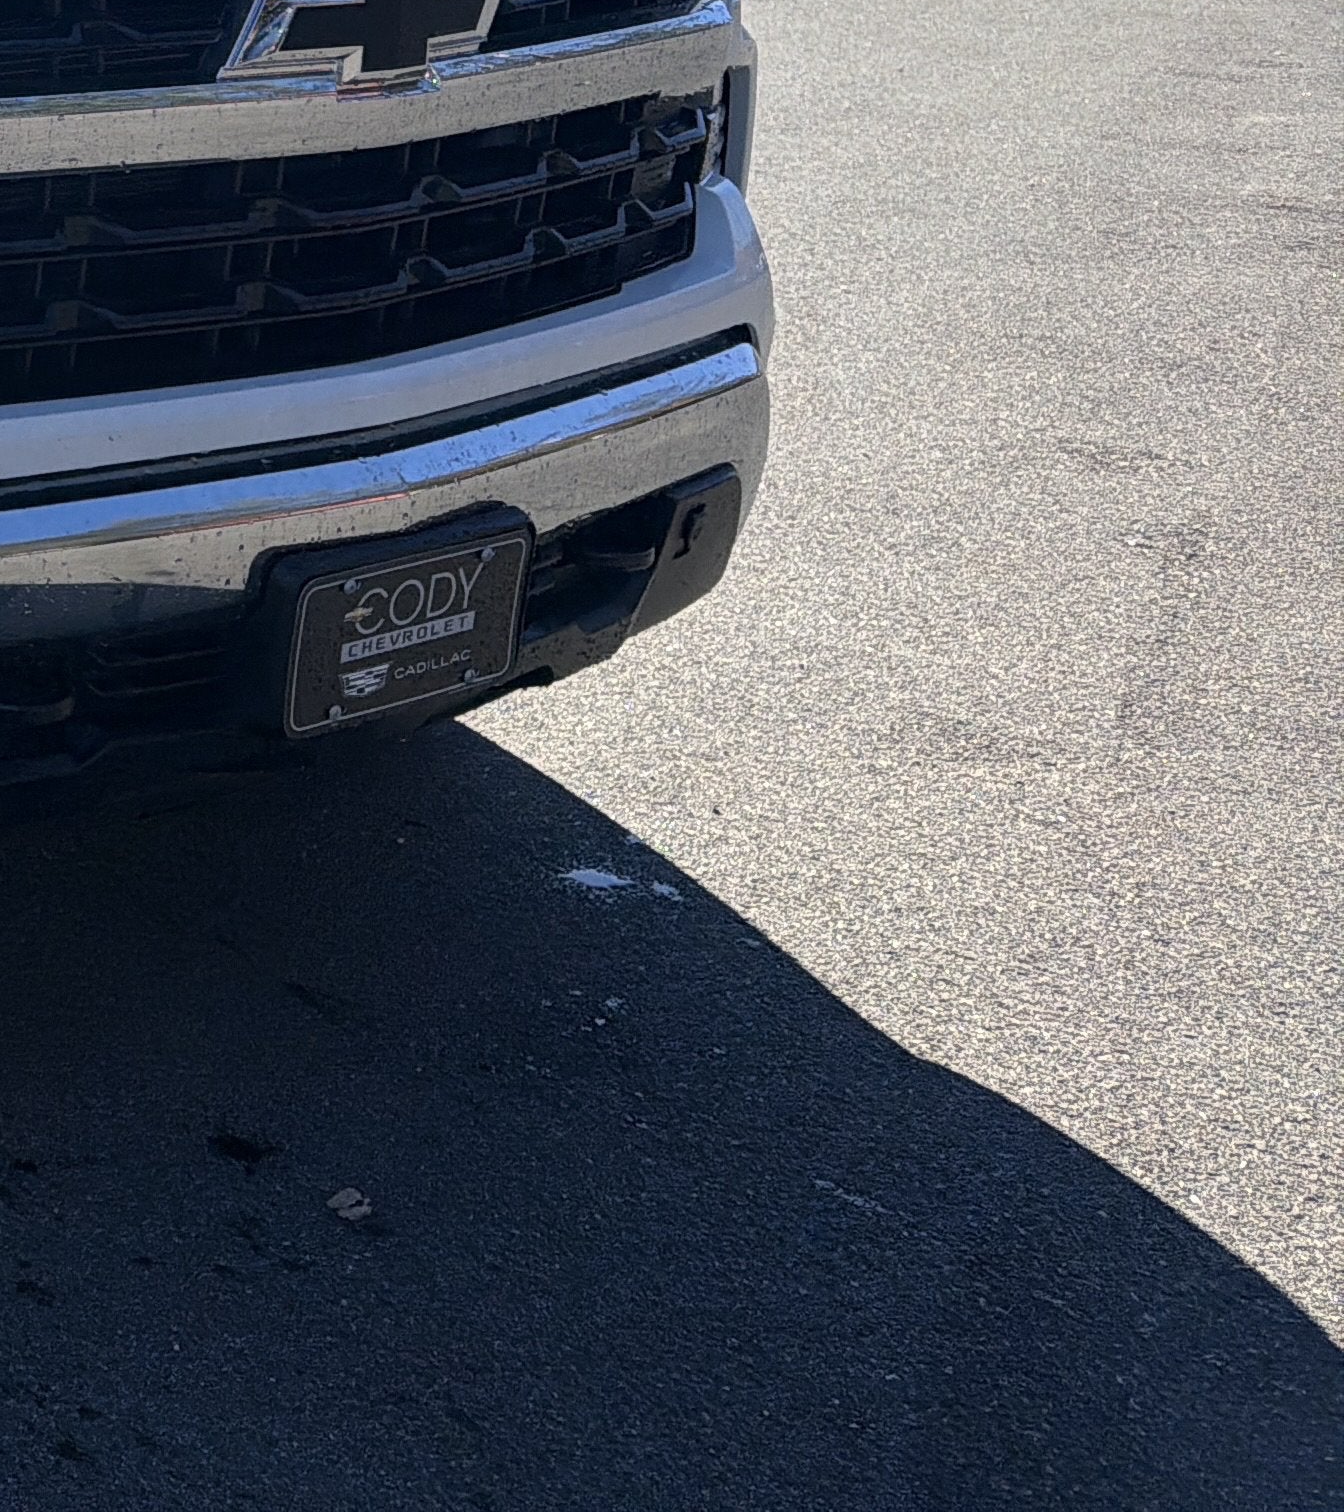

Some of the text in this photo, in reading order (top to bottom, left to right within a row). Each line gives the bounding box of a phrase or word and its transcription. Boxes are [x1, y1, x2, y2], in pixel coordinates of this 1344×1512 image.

[354, 561, 484, 635] CODY
[347, 614, 470, 658] CHEVROLET
[393, 649, 472, 680] CADILLAC
